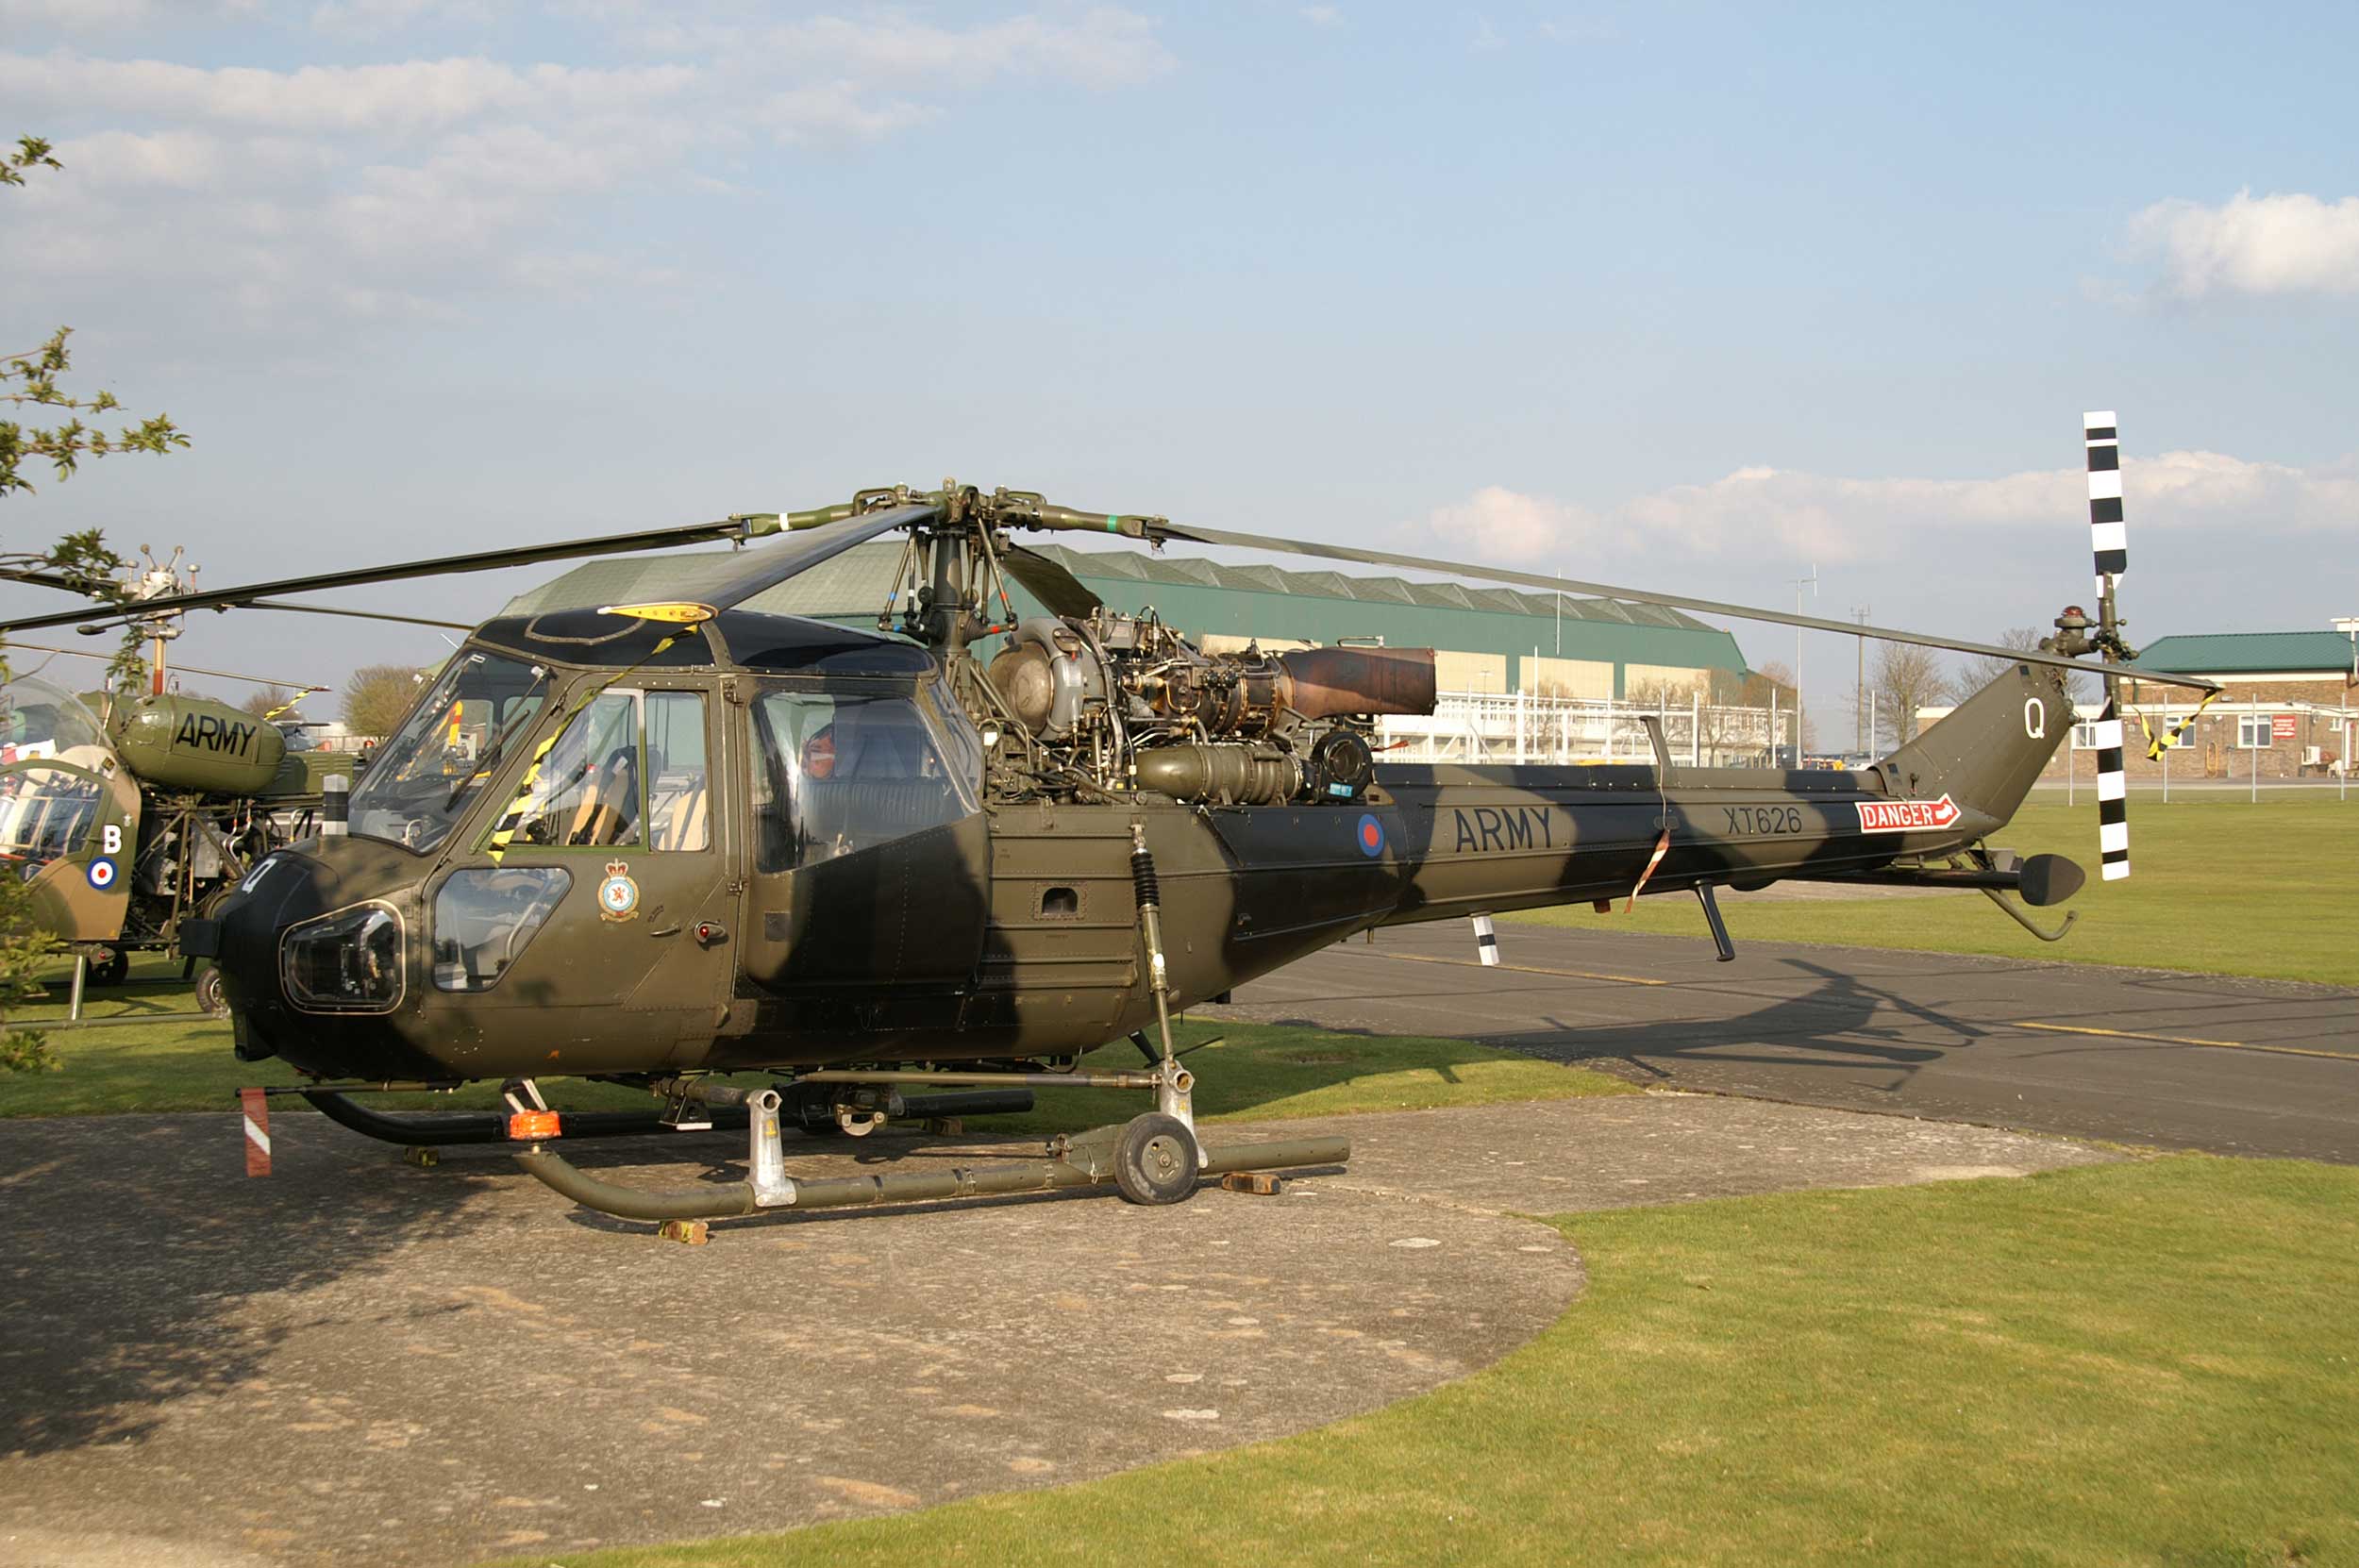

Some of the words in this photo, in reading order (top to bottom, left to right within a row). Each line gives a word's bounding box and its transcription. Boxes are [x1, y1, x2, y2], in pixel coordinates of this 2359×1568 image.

[176, 712, 257, 757] ARMY
[2024, 697, 2045, 739] Q
[1454, 807, 1550, 853] ARMY
[1723, 807, 1801, 834] XT626
[1863, 805, 1933, 827] DANGER
[104, 825, 122, 854] B
